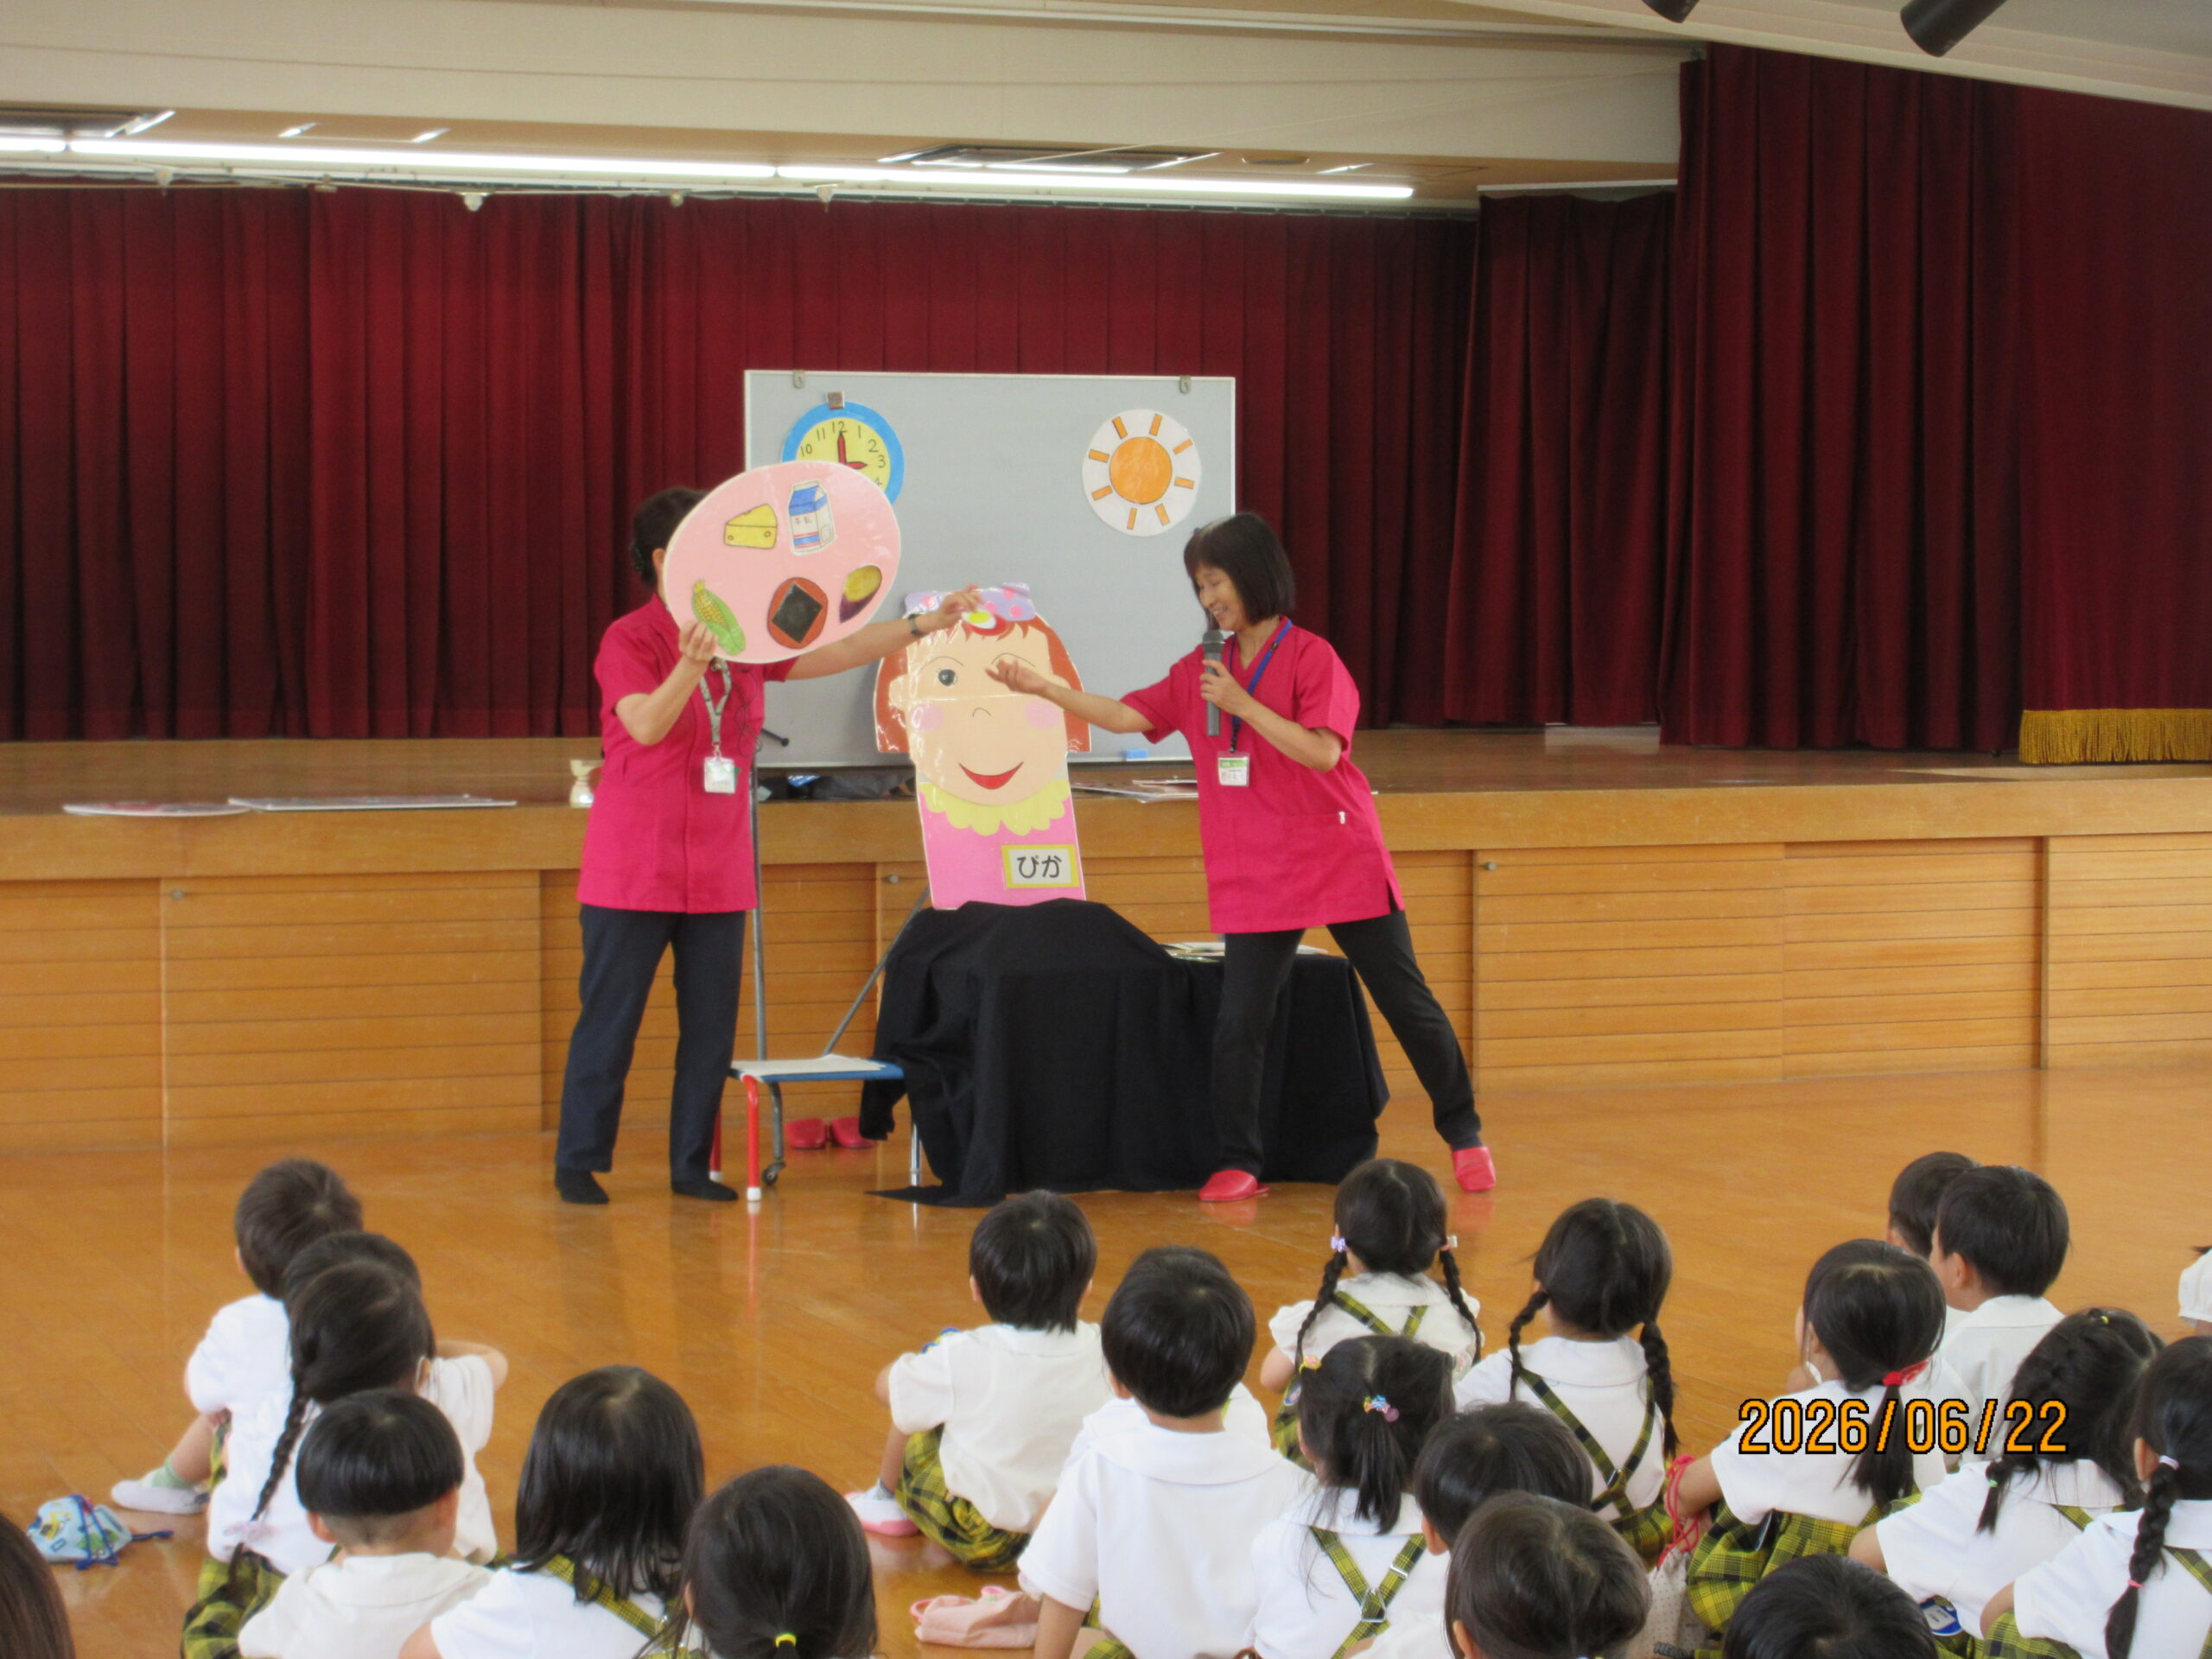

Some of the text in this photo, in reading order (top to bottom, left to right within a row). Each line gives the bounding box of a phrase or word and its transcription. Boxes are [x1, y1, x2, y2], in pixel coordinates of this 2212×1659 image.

[832, 421, 847, 433] 12
[817, 429, 826, 442] 11
[801, 443, 812, 456] 10
[868, 439, 879, 453] 2
[878, 455, 886, 468] 3
